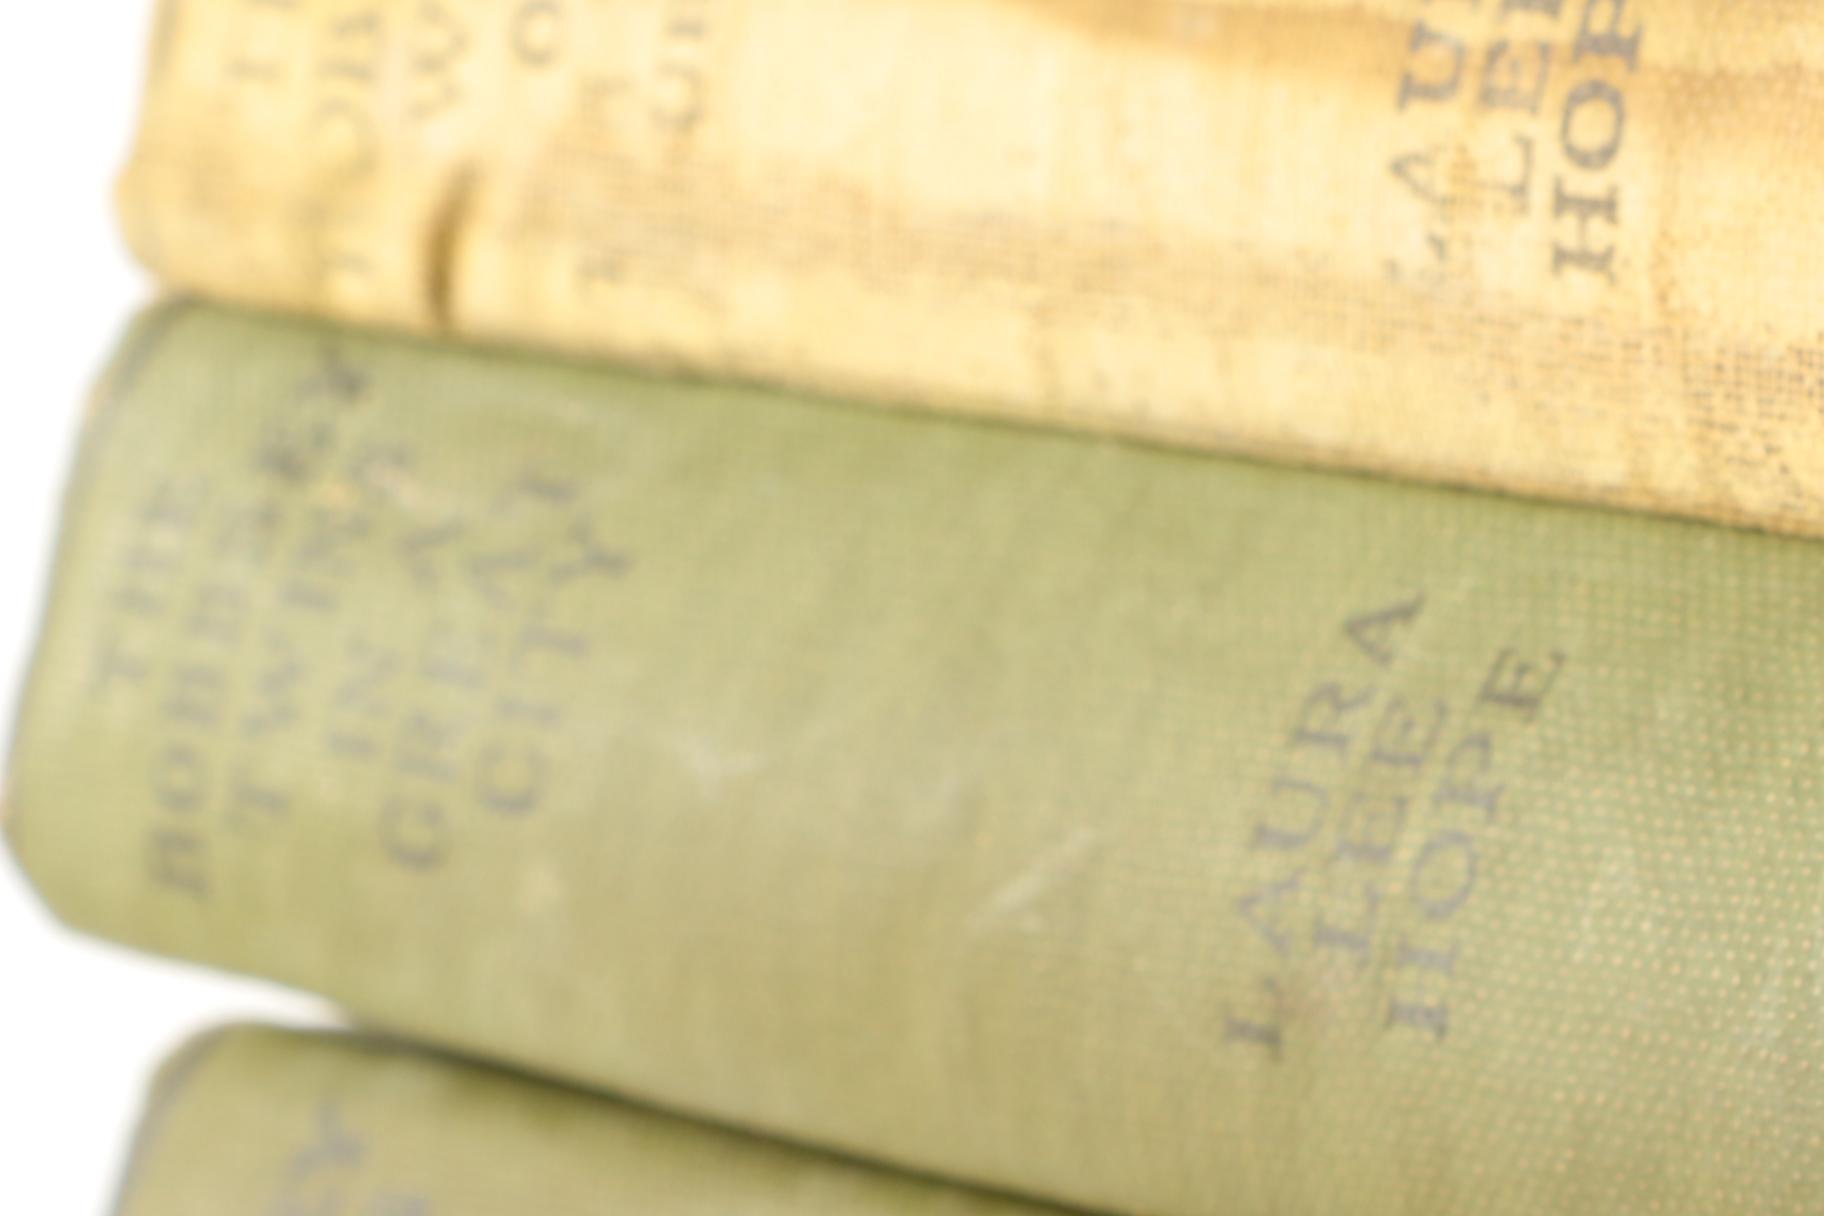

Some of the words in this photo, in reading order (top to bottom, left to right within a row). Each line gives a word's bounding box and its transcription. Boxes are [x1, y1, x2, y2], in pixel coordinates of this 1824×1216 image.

[1223, 590, 1426, 1064] LAURA
[1313, 696, 1450, 974] LEE
[1386, 645, 1568, 1044] HOPE
